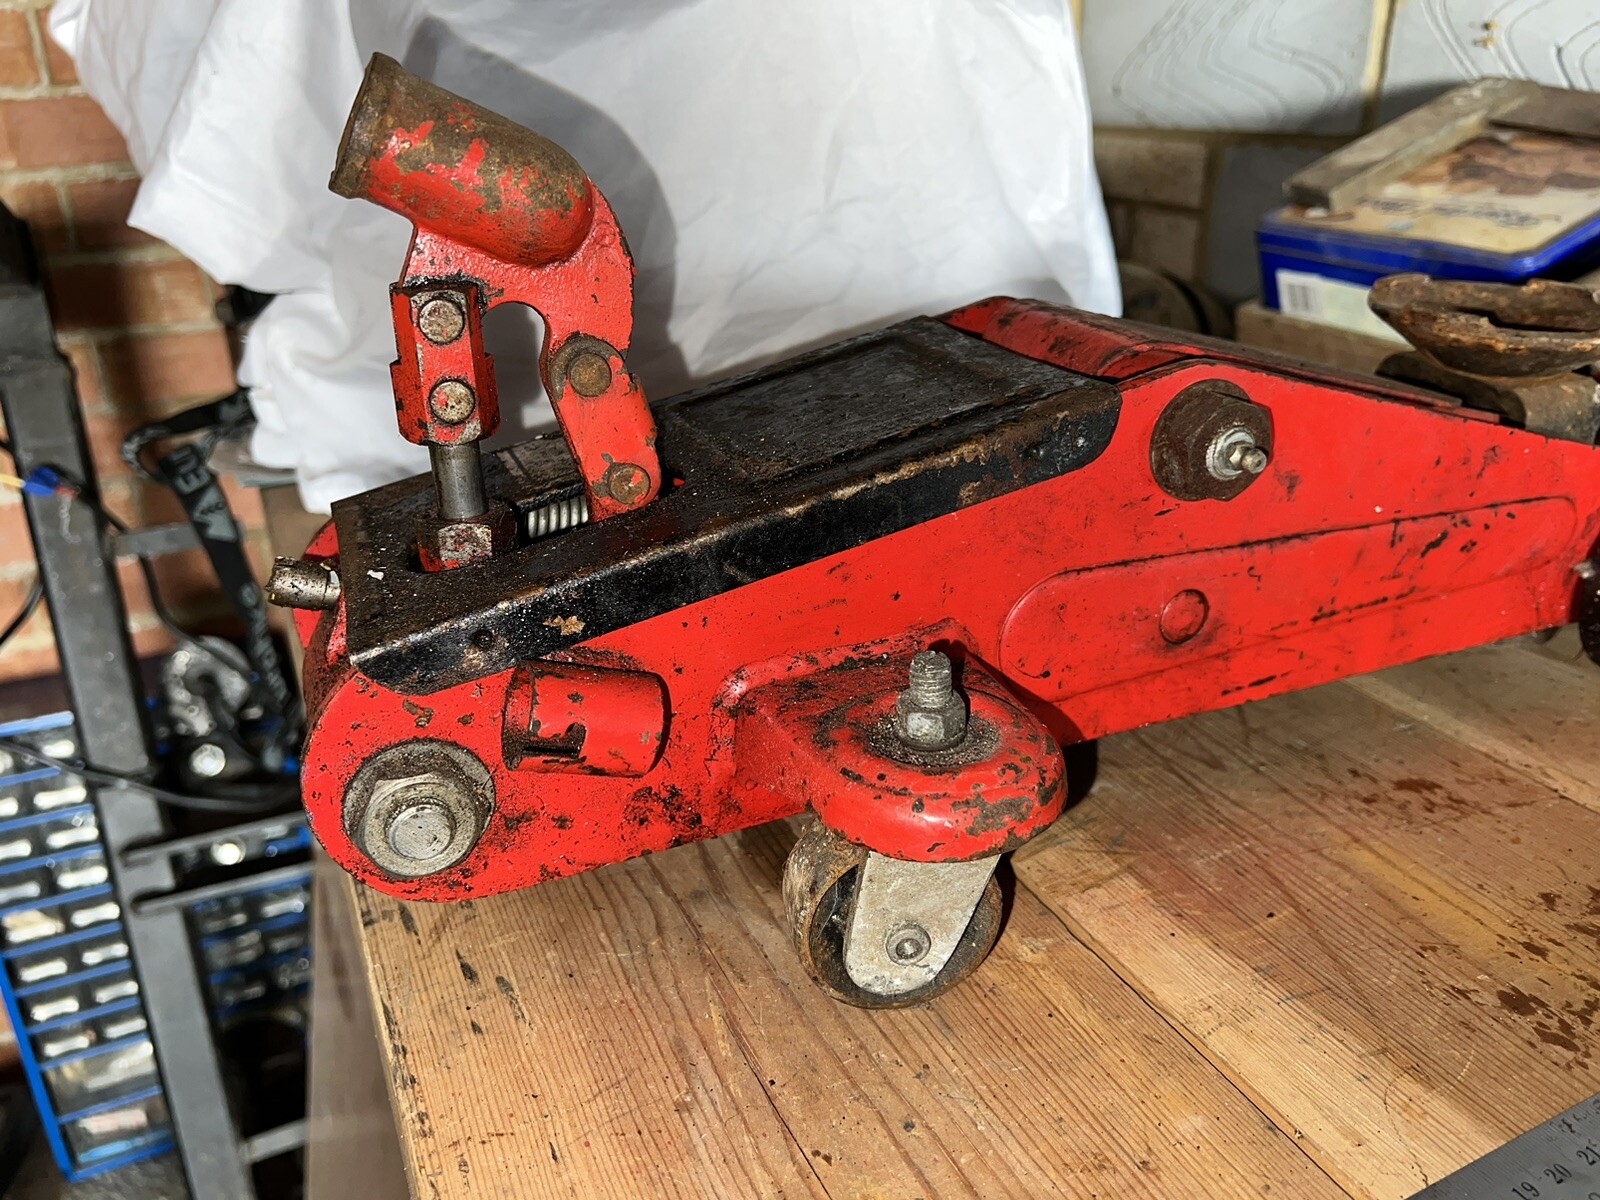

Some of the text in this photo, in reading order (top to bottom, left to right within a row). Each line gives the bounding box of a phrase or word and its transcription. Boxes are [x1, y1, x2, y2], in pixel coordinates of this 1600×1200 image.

[1512, 1145, 1600, 1200] 19 20 21
